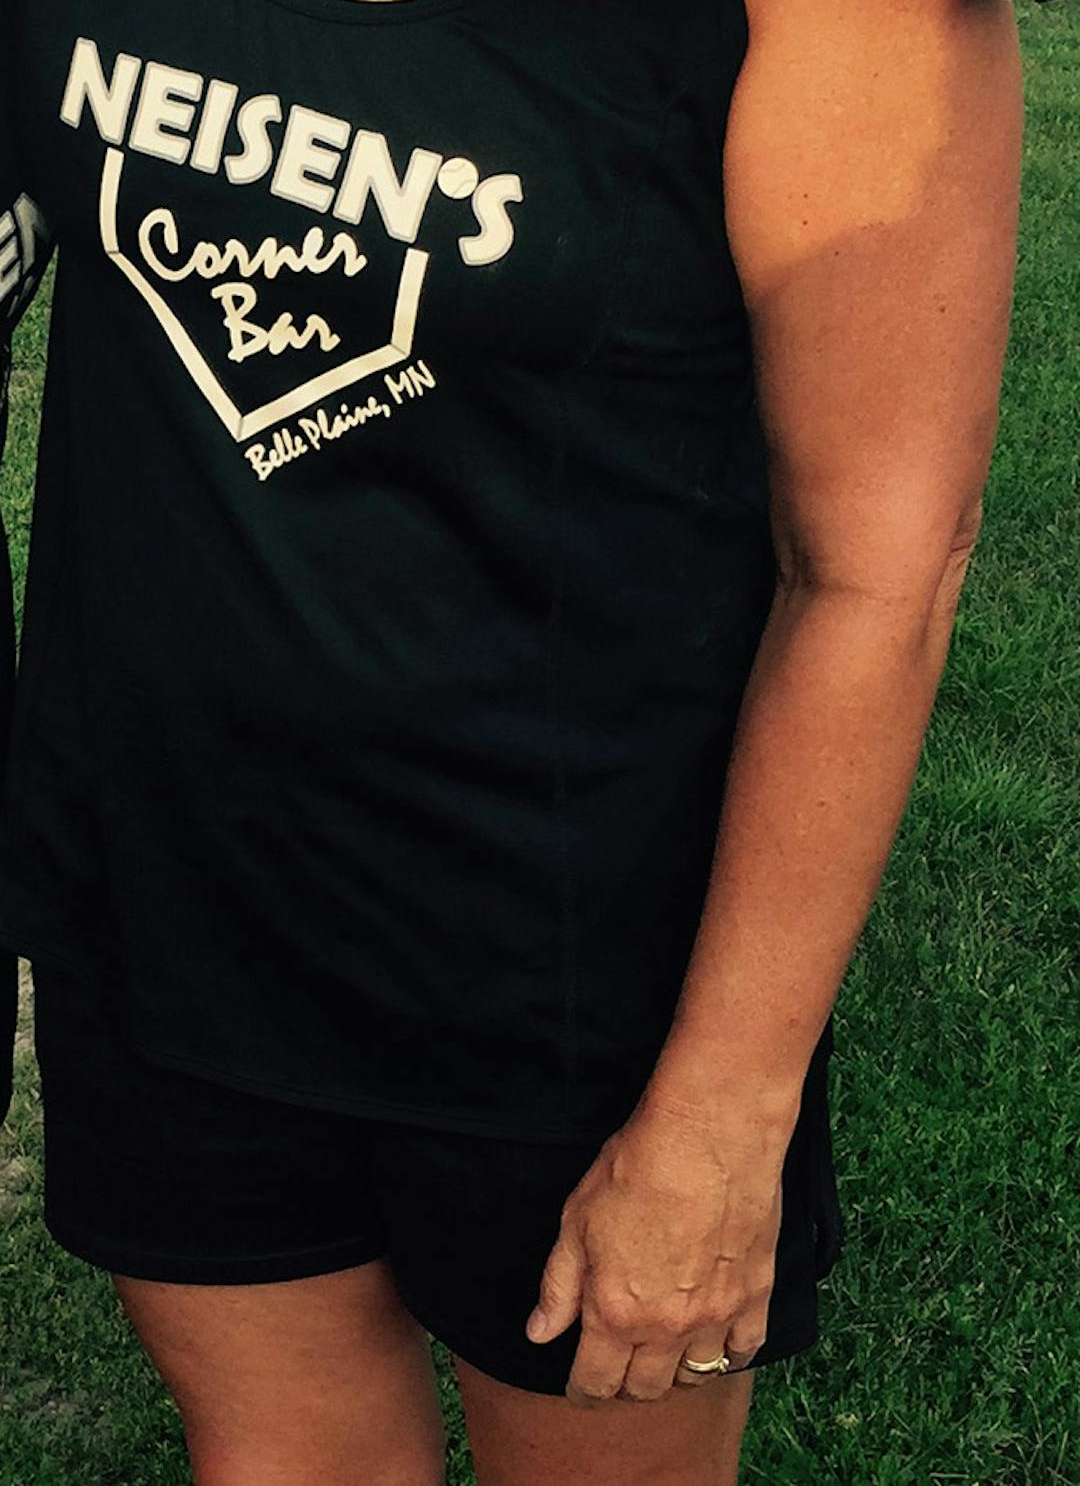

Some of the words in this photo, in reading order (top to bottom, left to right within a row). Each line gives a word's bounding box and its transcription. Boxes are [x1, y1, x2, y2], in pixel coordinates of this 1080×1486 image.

[59, 36, 524, 267] NEISEN'S
[137, 207, 368, 282] Corner
[211, 282, 341, 363] Bar
[243, 427, 309, 482] Belle
[383, 359, 437, 405] MN
